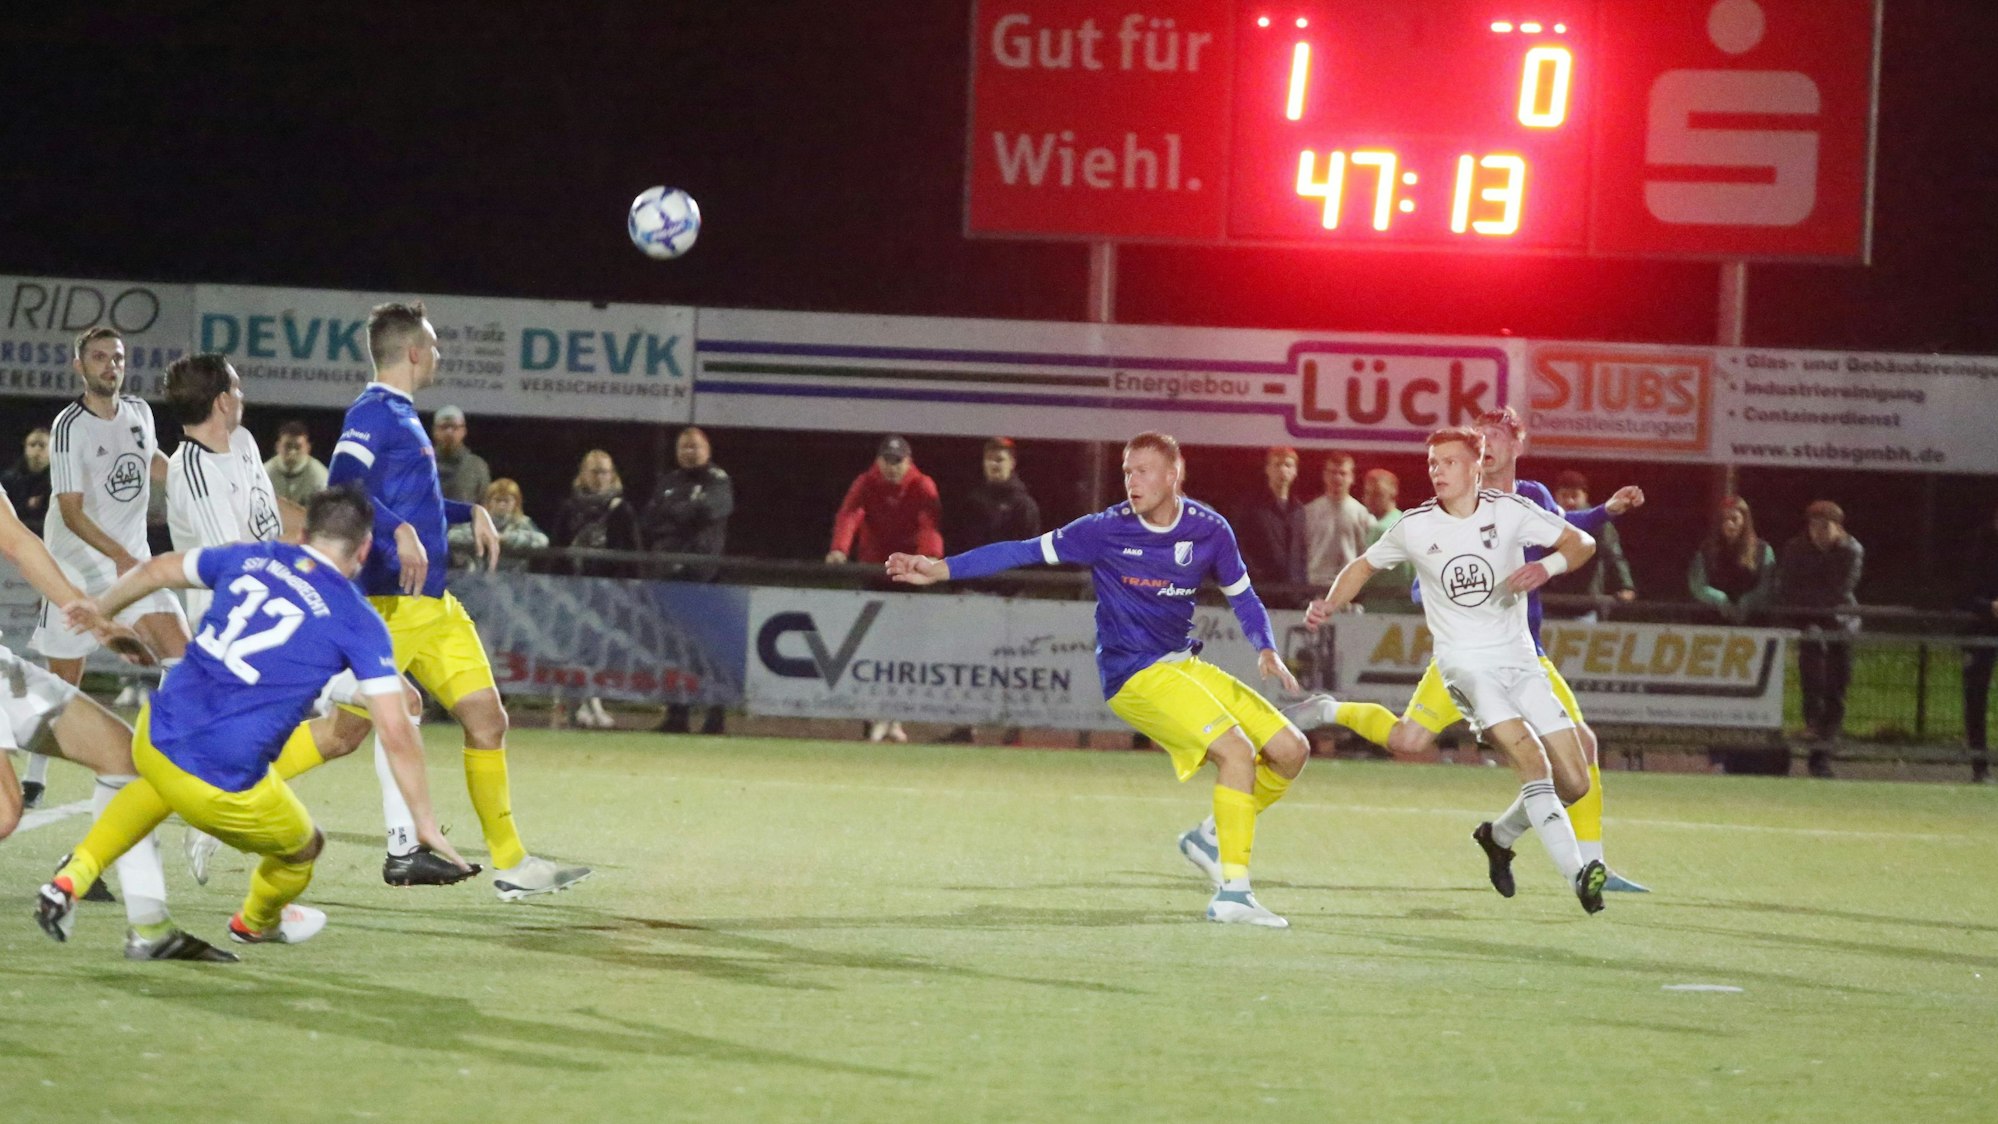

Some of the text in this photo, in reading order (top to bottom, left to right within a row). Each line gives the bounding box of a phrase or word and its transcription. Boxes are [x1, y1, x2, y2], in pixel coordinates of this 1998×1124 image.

[992, 13, 1213, 72] Gut für
[1286, 42, 1310, 120] 1
[1518, 46, 1571, 127] 0
[993, 130, 1202, 191] Wiehl.
[9, 282, 159, 334] RIDO
[201, 312, 367, 362] DEVK
[520, 328, 683, 377] DEVK
[1114, 371, 1250, 398] Energiebau
[1531, 353, 1697, 417] STUBS
[1746, 354, 1795, 370] Glas-
[1802, 358, 1839, 371] und
[520, 378, 686, 398] VERSICHERUNGEN
[1303, 359, 1490, 427] Lück
[1744, 379, 1926, 404] Industriereinigung
[1530, 412, 1696, 437] Dienstleistungen
[1743, 407, 1900, 427] Containerdienst
[1731, 443, 1946, 464] www.stubsgmbh.de
[1123, 547, 1143, 557] JAKO
[195, 574, 305, 685] 32
[757, 601, 885, 691] CV
[1369, 622, 1758, 680] APFELDER
[853, 659, 1072, 692] CHRISTENSEN
